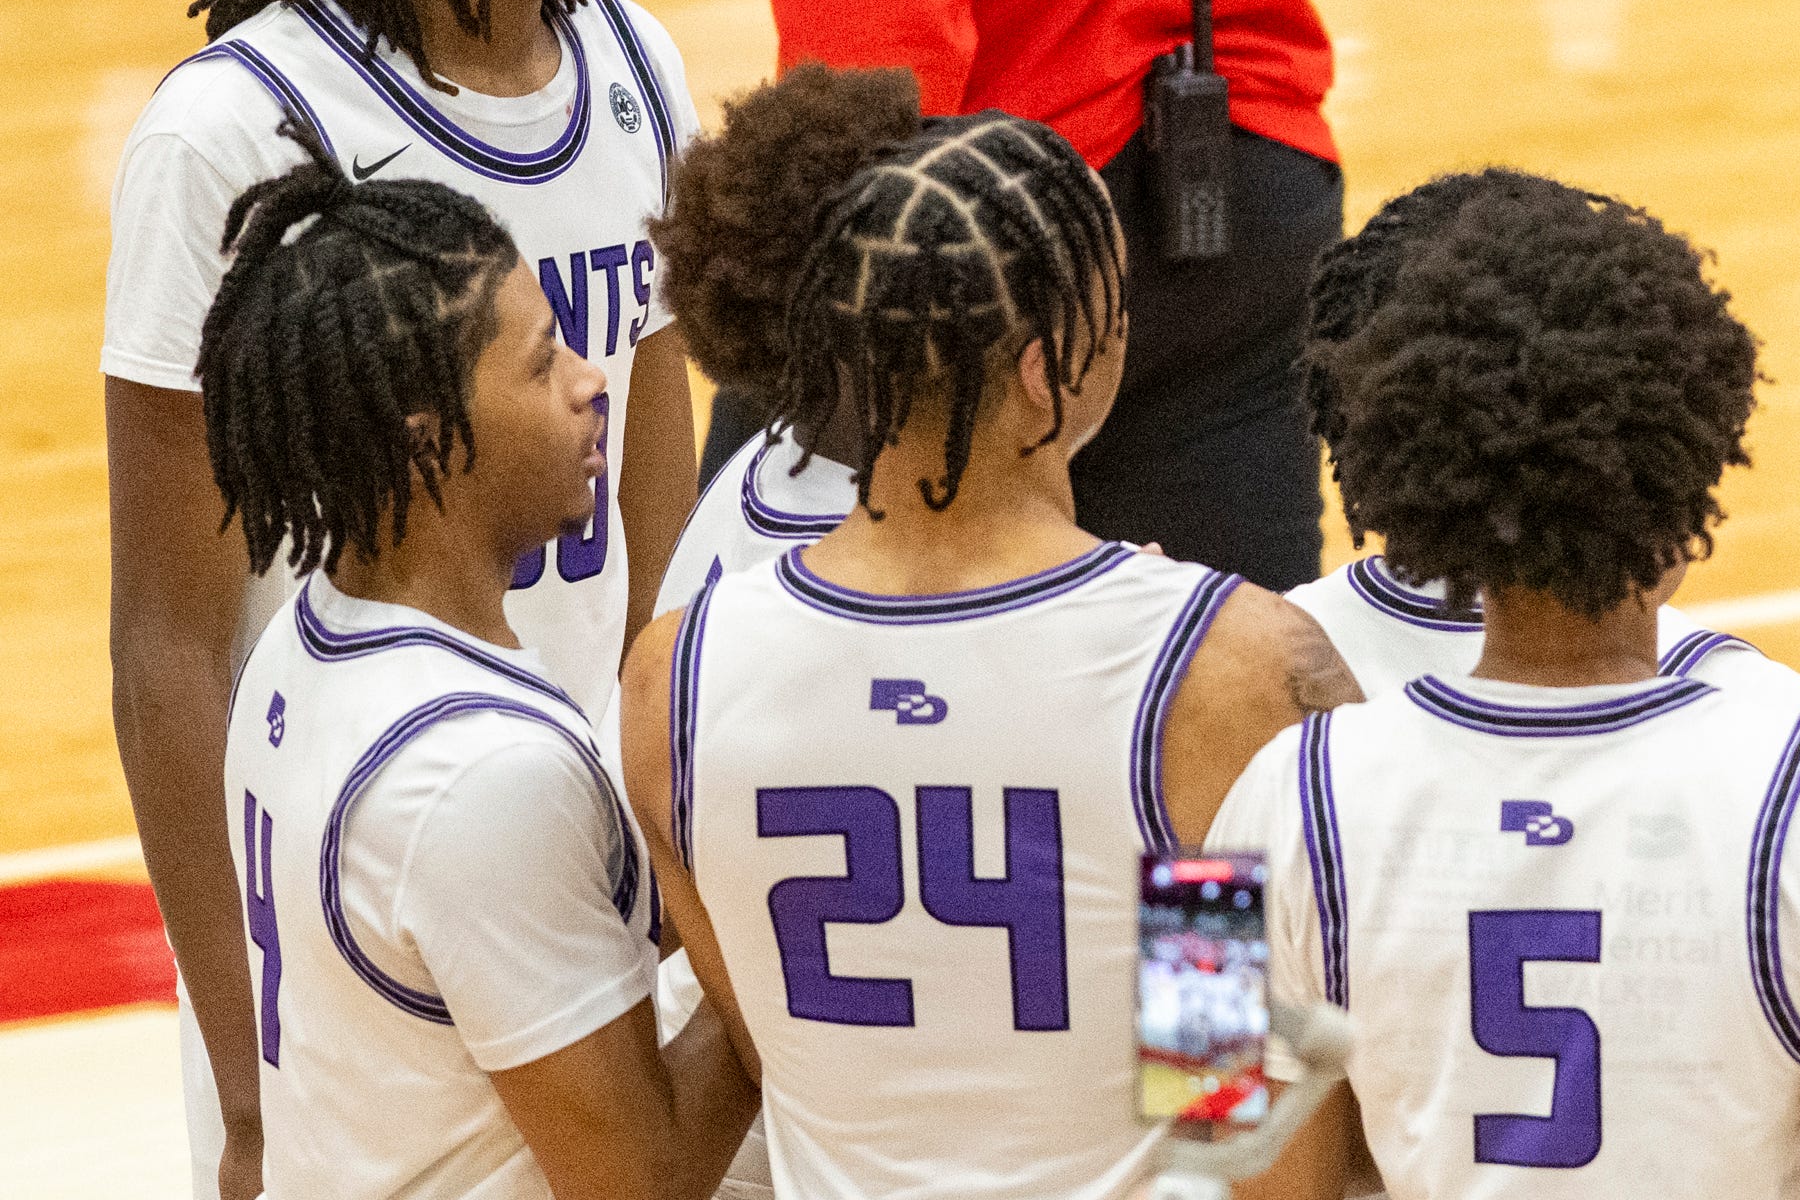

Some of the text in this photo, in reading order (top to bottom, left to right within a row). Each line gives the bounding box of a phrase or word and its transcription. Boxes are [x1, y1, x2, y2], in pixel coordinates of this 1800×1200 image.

[538, 239, 655, 360] NTS
[244, 787, 283, 1070] 4
[756, 784, 1070, 1032] 24
[1593, 879, 1715, 918] Merit
[1607, 928, 1723, 965] ental
[1468, 909, 1603, 1169] 5
